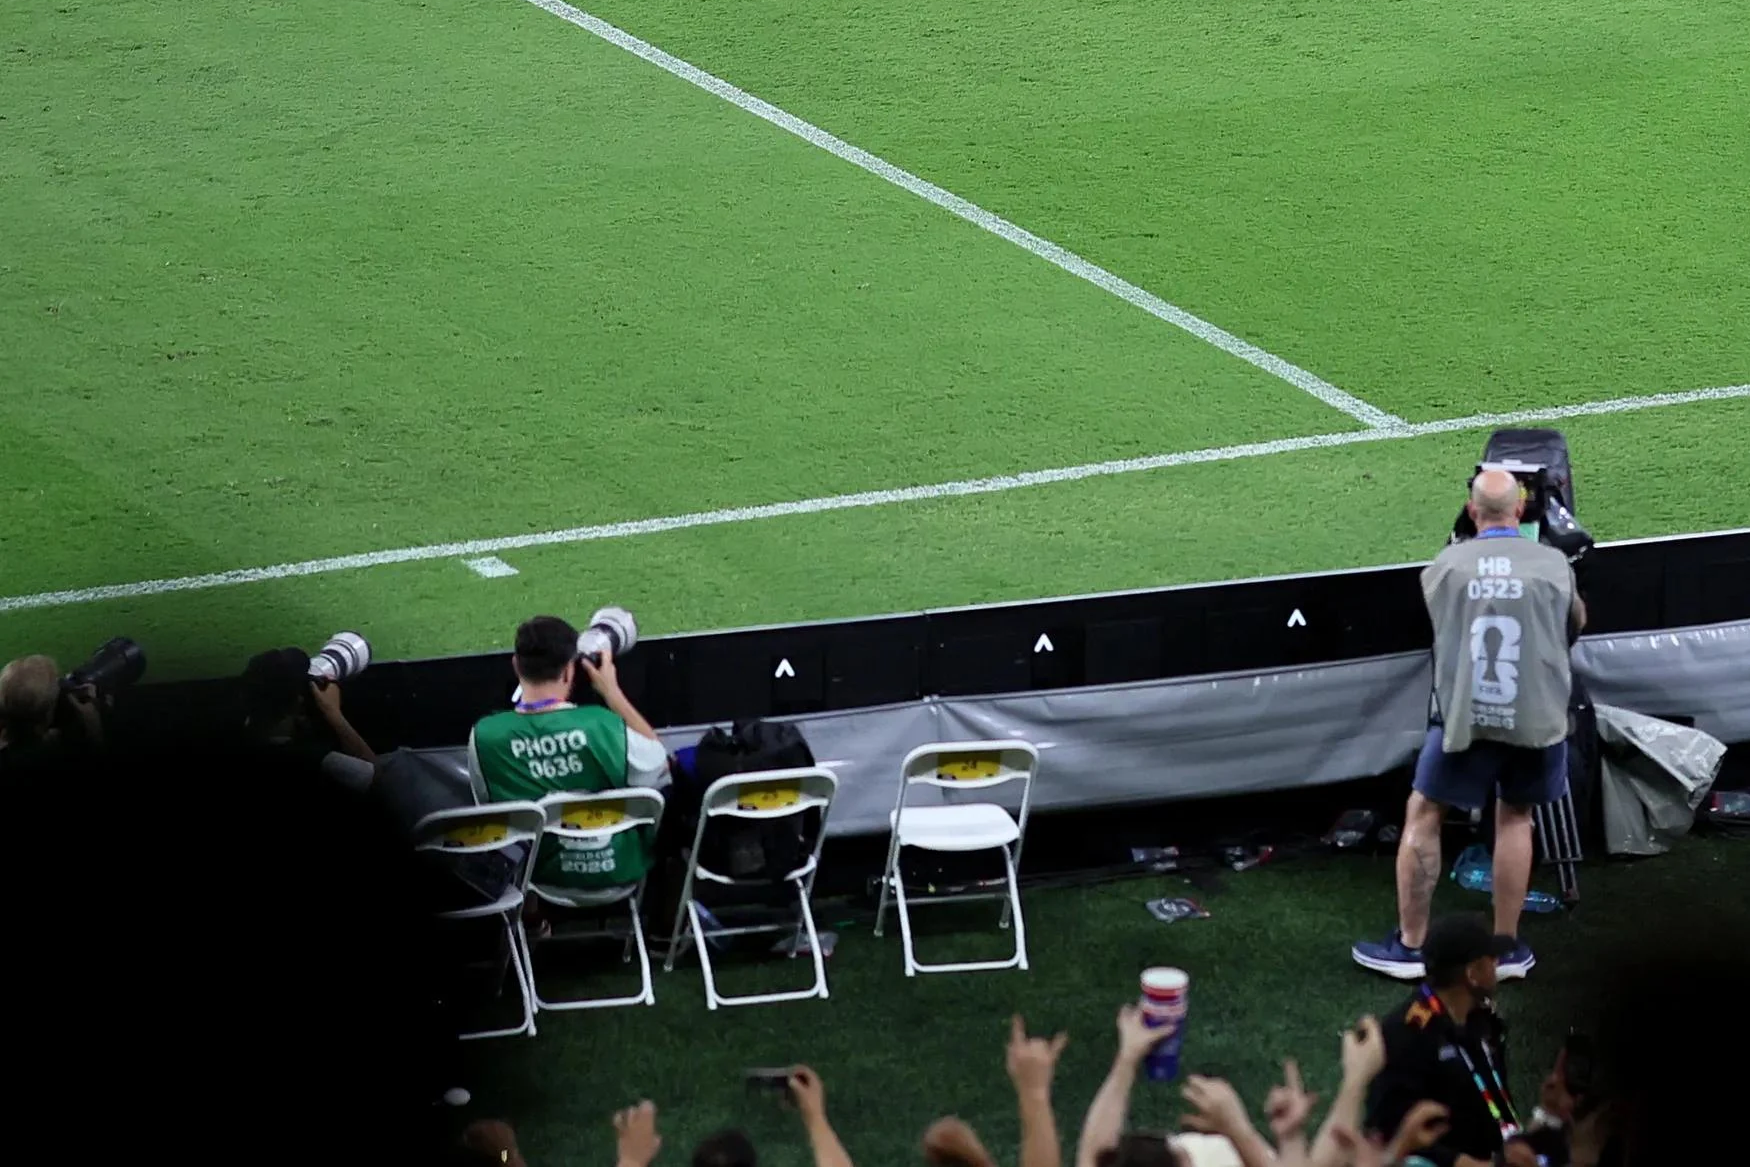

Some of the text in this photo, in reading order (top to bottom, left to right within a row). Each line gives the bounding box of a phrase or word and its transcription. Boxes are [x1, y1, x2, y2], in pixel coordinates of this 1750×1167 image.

[1477, 556, 1512, 576] HB
[1467, 578, 1524, 600] 0523
[510, 729, 588, 758] PHOTO
[528, 753, 584, 779] 0636
